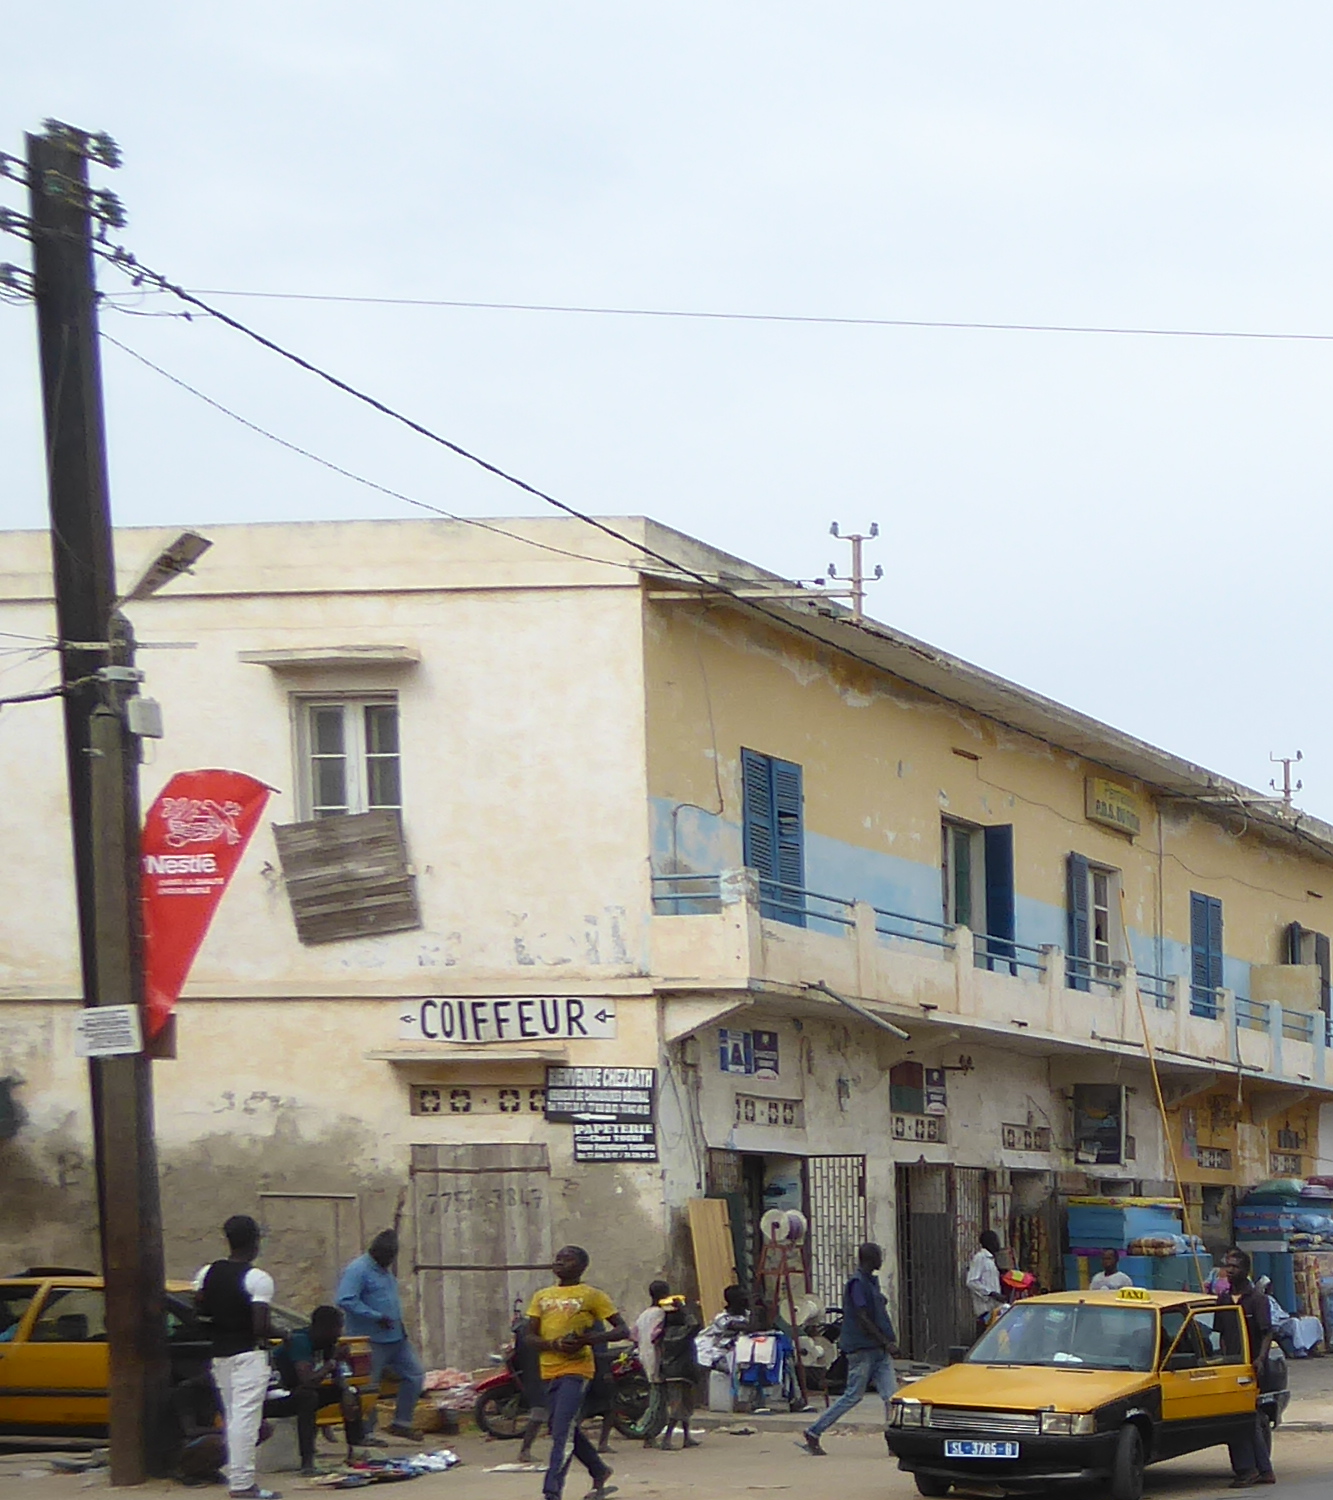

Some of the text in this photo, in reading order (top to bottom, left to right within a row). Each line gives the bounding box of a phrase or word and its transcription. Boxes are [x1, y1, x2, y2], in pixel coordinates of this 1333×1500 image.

[419, 998, 588, 1041] COIFFEUR
[574, 1123, 653, 1135] PAPETERIE
[1120, 1289, 1144, 1300] TAXI
